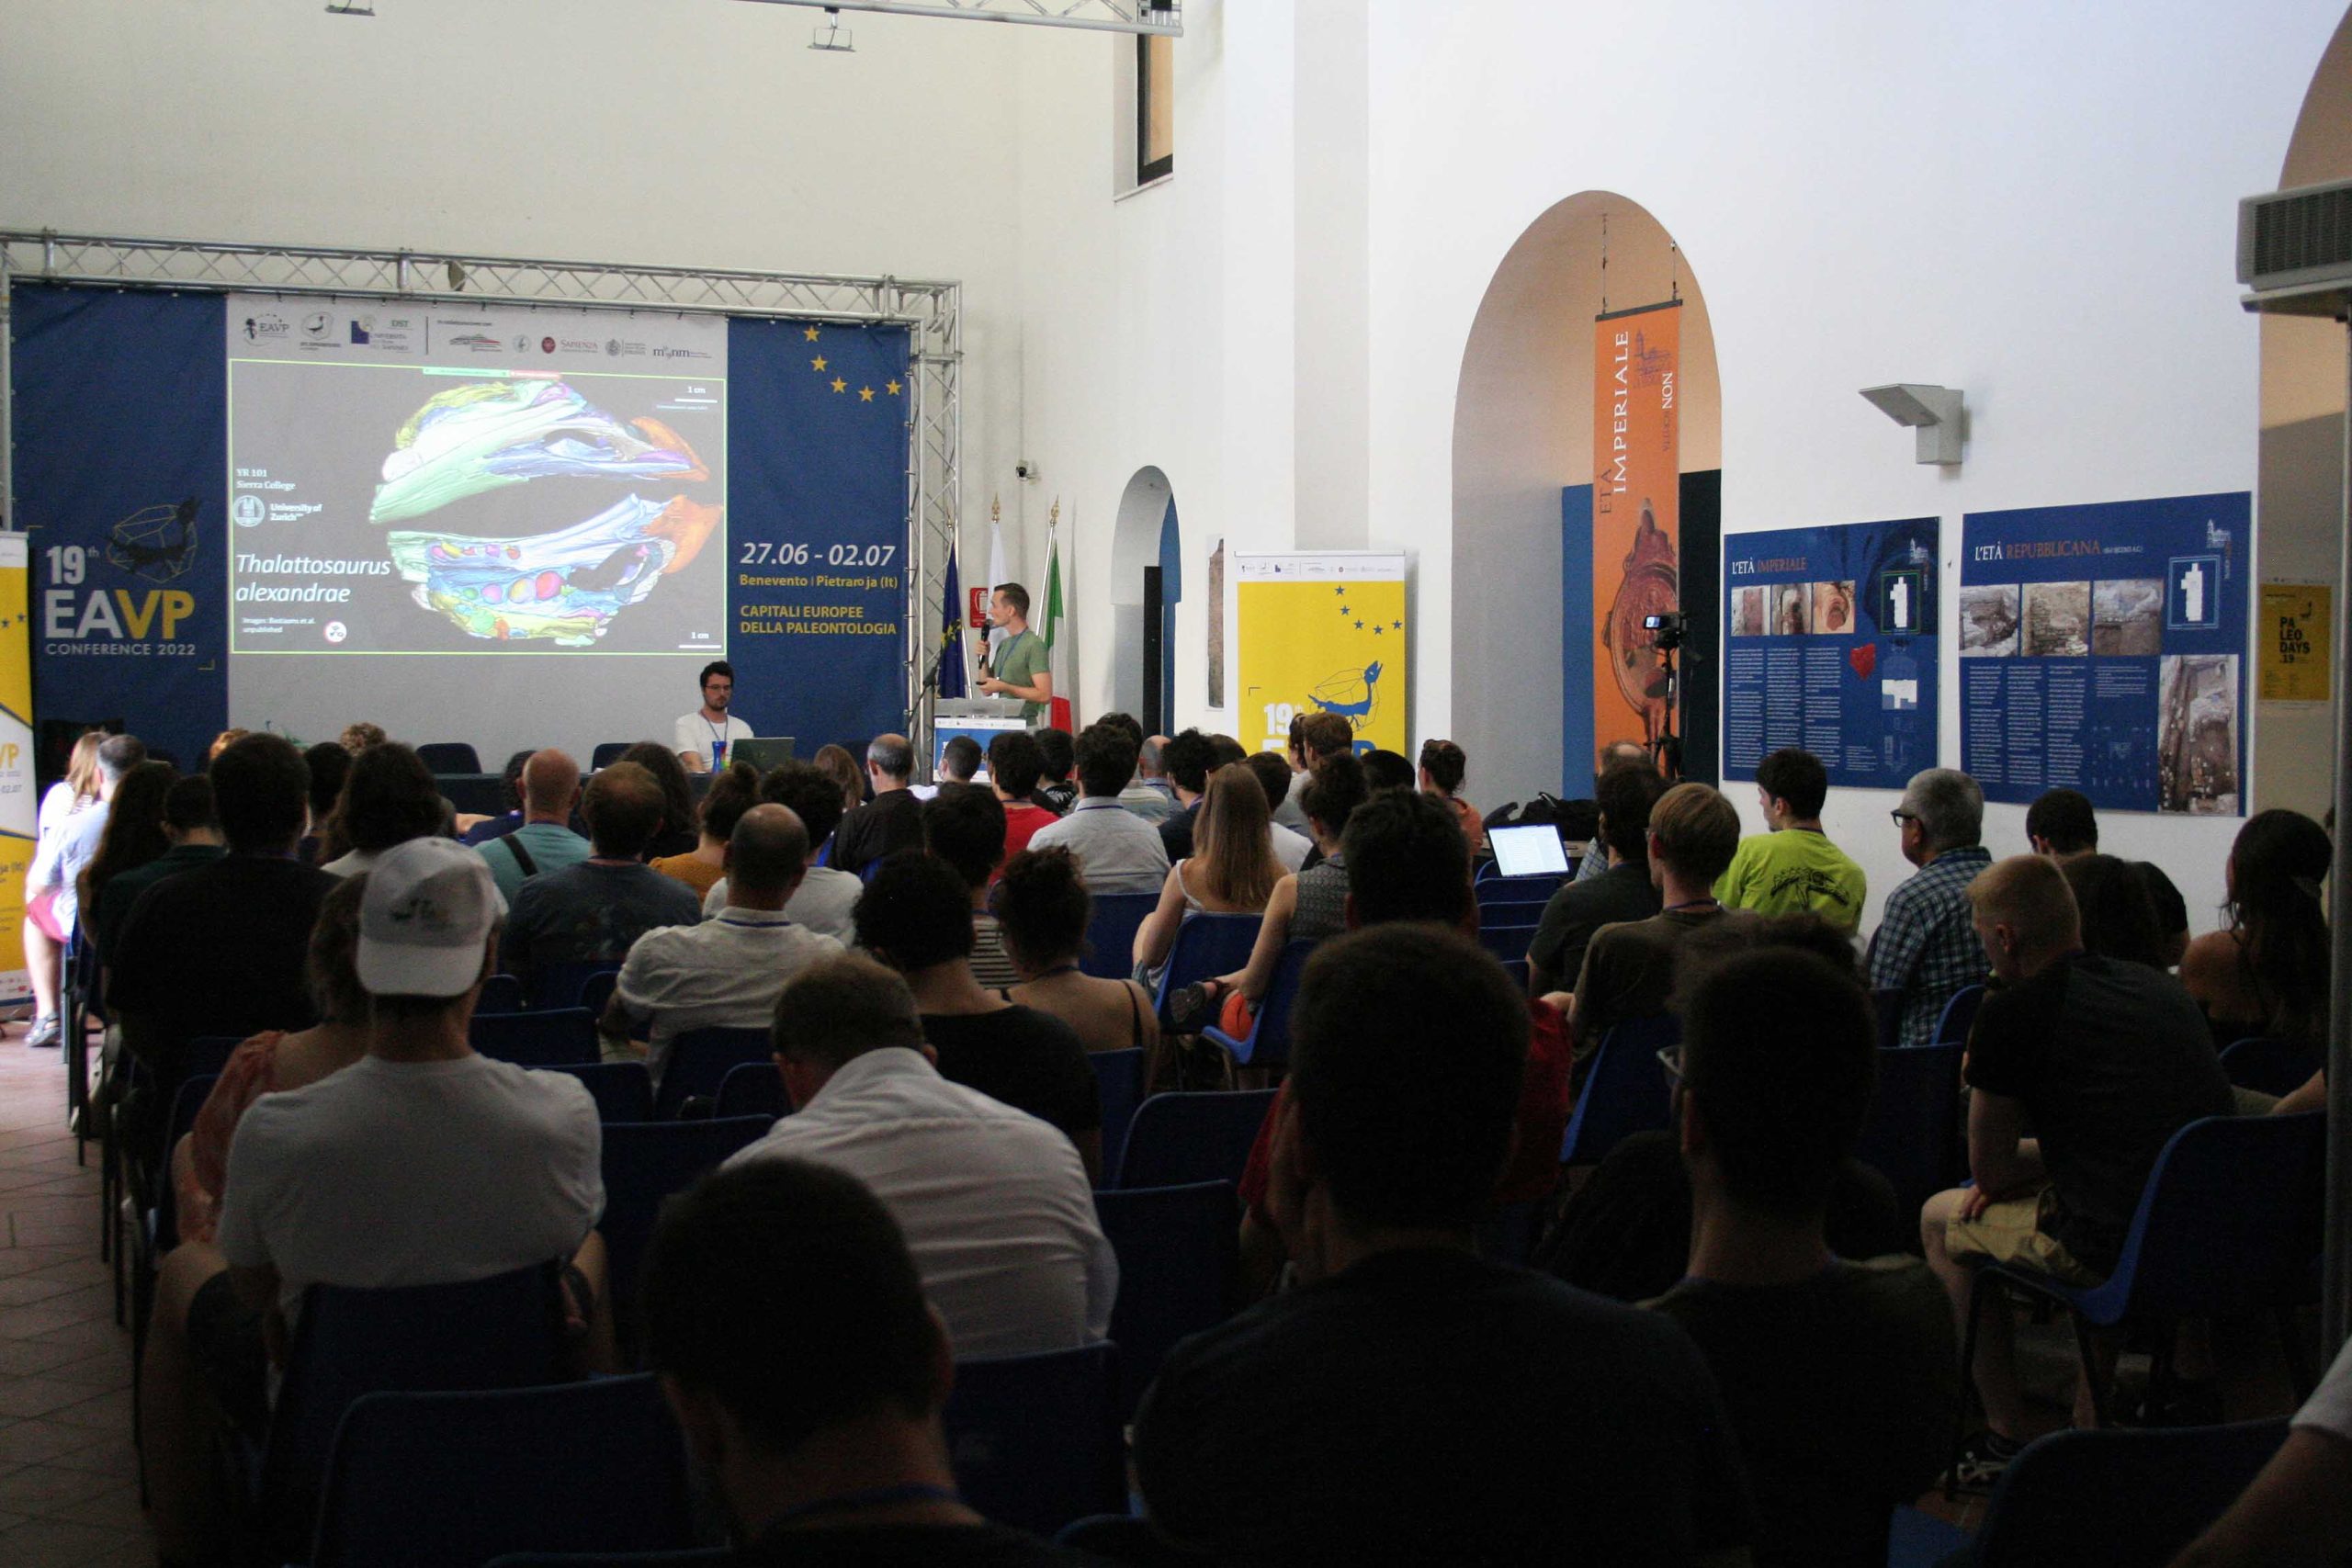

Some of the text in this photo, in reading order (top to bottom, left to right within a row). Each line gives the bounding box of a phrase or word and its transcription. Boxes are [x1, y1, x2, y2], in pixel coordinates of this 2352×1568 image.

[1661, 372, 1673, 409] NON
[1613, 332, 1629, 492] IMPERIALE
[265, 481, 296, 491] College
[270, 503, 311, 513] University
[740, 543, 808, 565] 27.06
[829, 545, 896, 566] 02.07
[2006, 540, 2100, 558] REPUBBLICANA
[236, 554, 391, 575] Thalattosaurus
[1758, 558, 1807, 573] IMPERIALE
[740, 574, 808, 586] Benevento
[880, 577, 898, 588] (It)
[236, 582, 351, 603] alexandrae
[45, 590, 195, 639] EAVP
[741, 605, 864, 618] CAPITALI EUROPEE
[741, 622, 897, 635] DELLA PALEONTOLOGIA
[2279, 616, 2295, 628] PA
[2279, 629, 2302, 641] LEO
[47, 644, 196, 655] CONFERENCE 2022
[2279, 642, 2310, 654] DAYS
